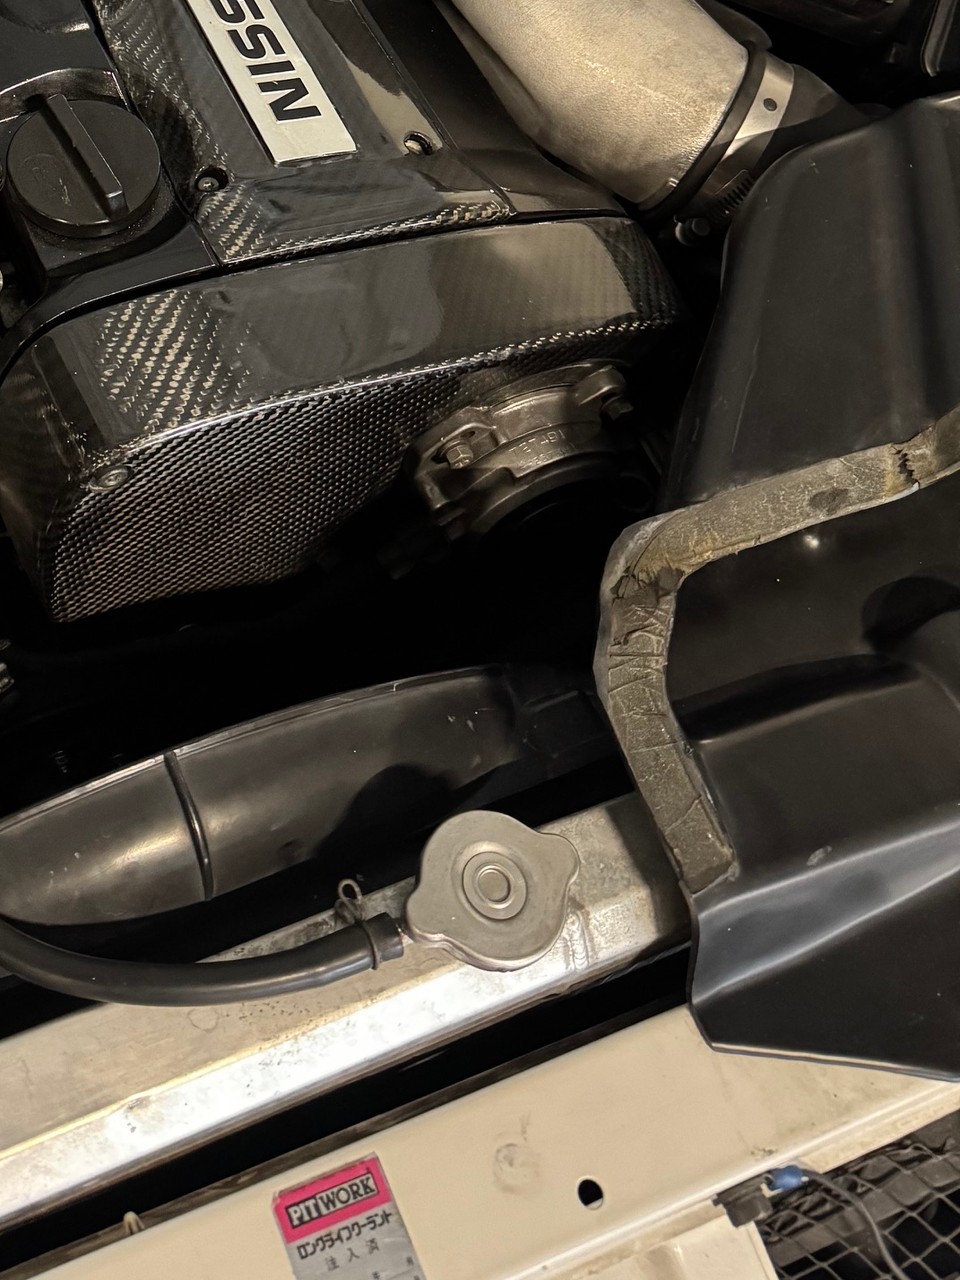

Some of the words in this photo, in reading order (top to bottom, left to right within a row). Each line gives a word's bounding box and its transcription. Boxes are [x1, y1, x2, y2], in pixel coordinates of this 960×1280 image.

[287, 1177, 375, 1227] PITWORK
[297, 1210, 393, 1259] ロングライフクーラント
